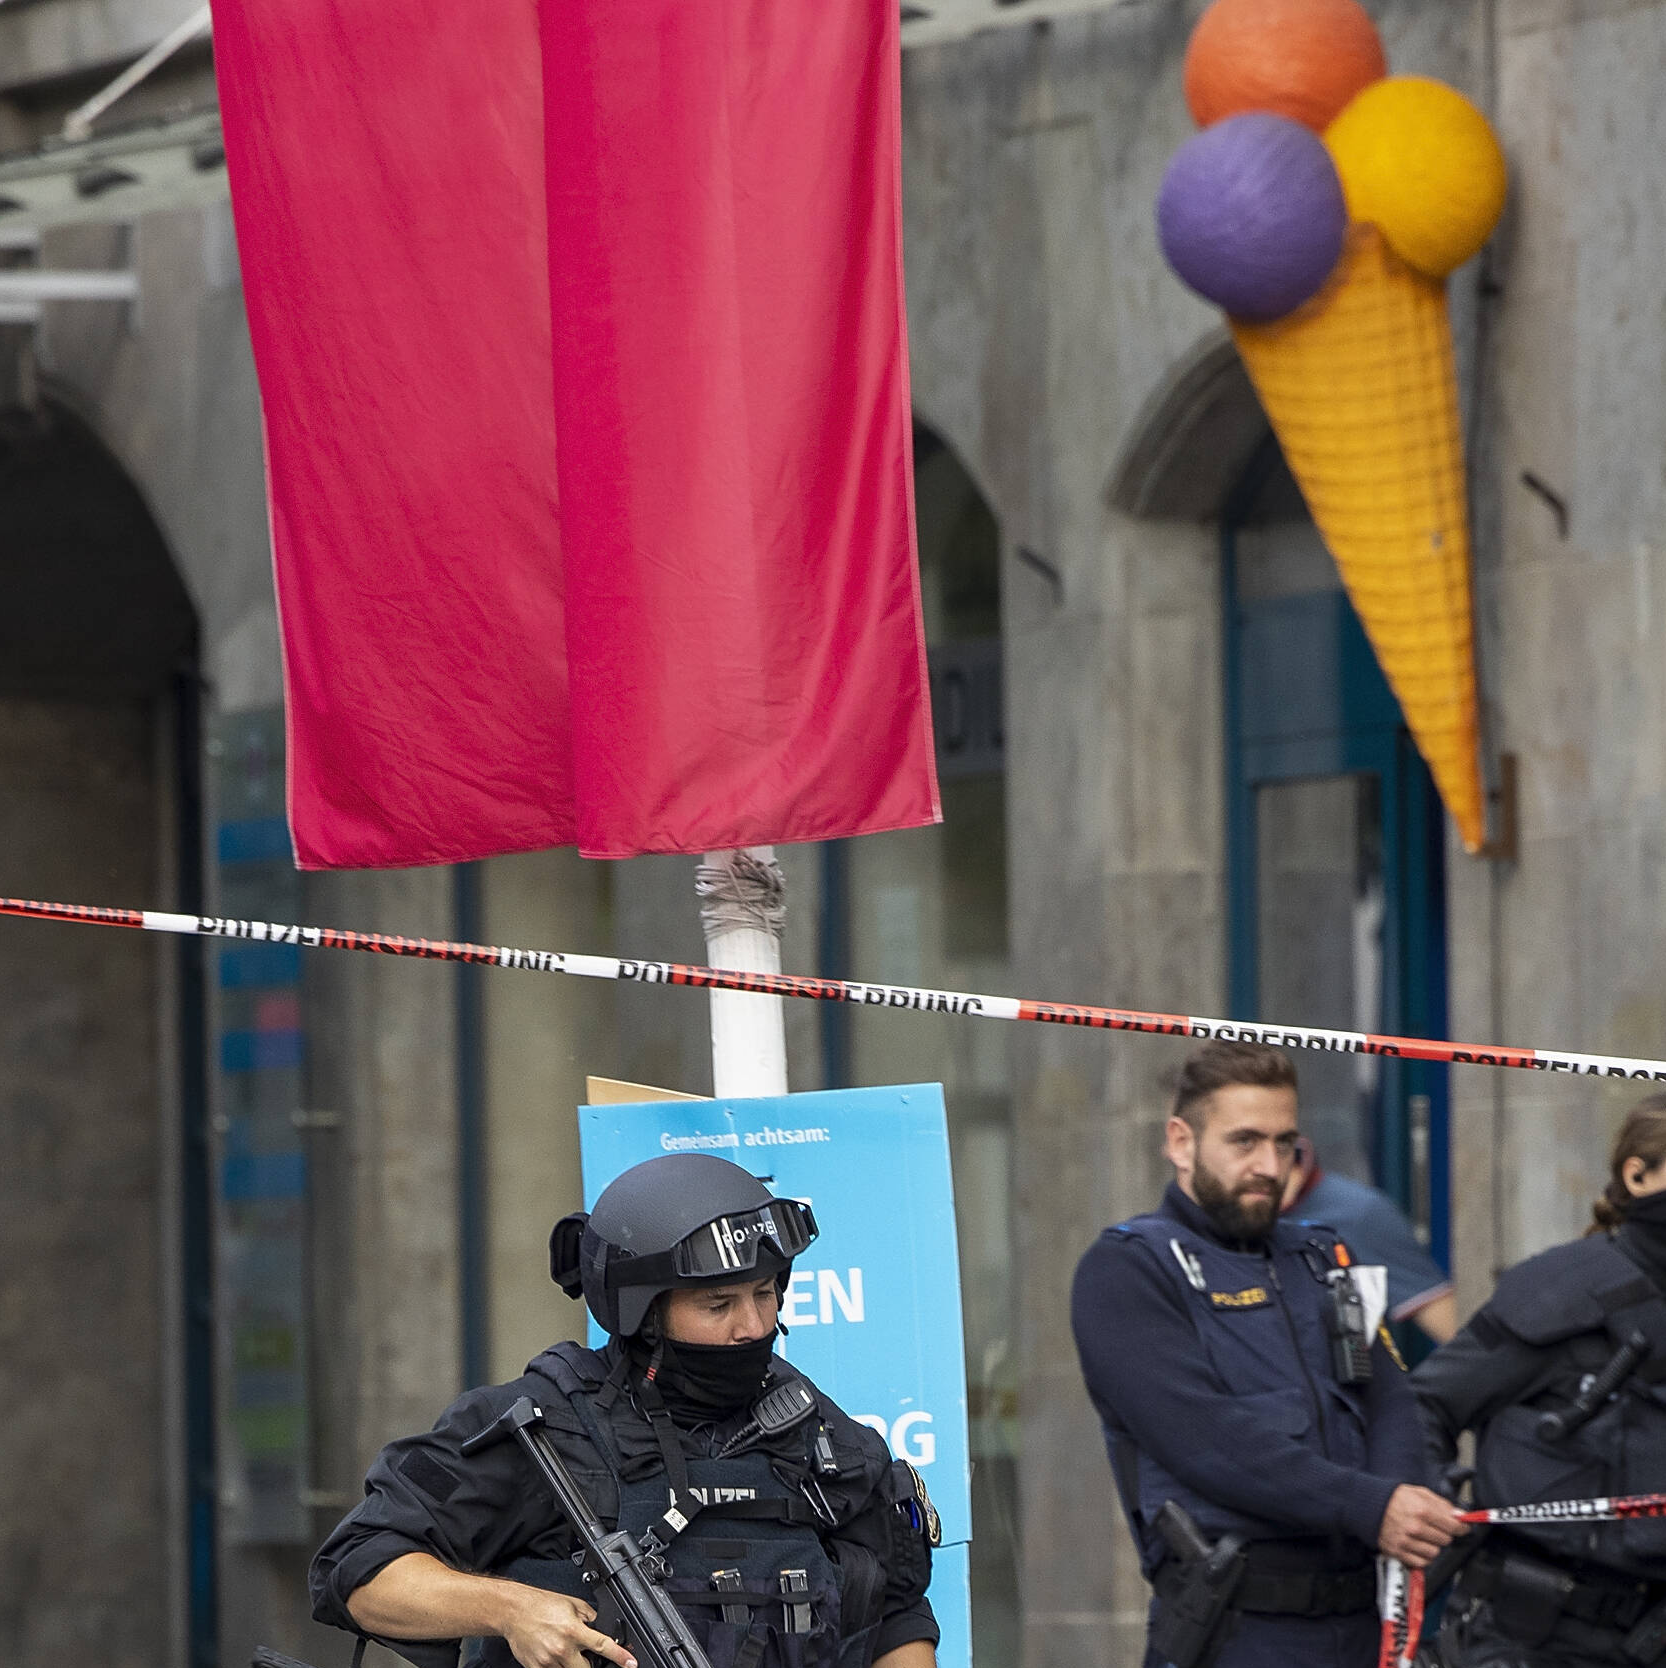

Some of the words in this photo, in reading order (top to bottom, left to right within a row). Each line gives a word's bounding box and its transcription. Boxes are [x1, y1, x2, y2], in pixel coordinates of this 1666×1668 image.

[660, 1130, 740, 1151] Gemeinsam
[744, 1126, 831, 1147] achtsam:
[783, 1267, 865, 1327] EN
